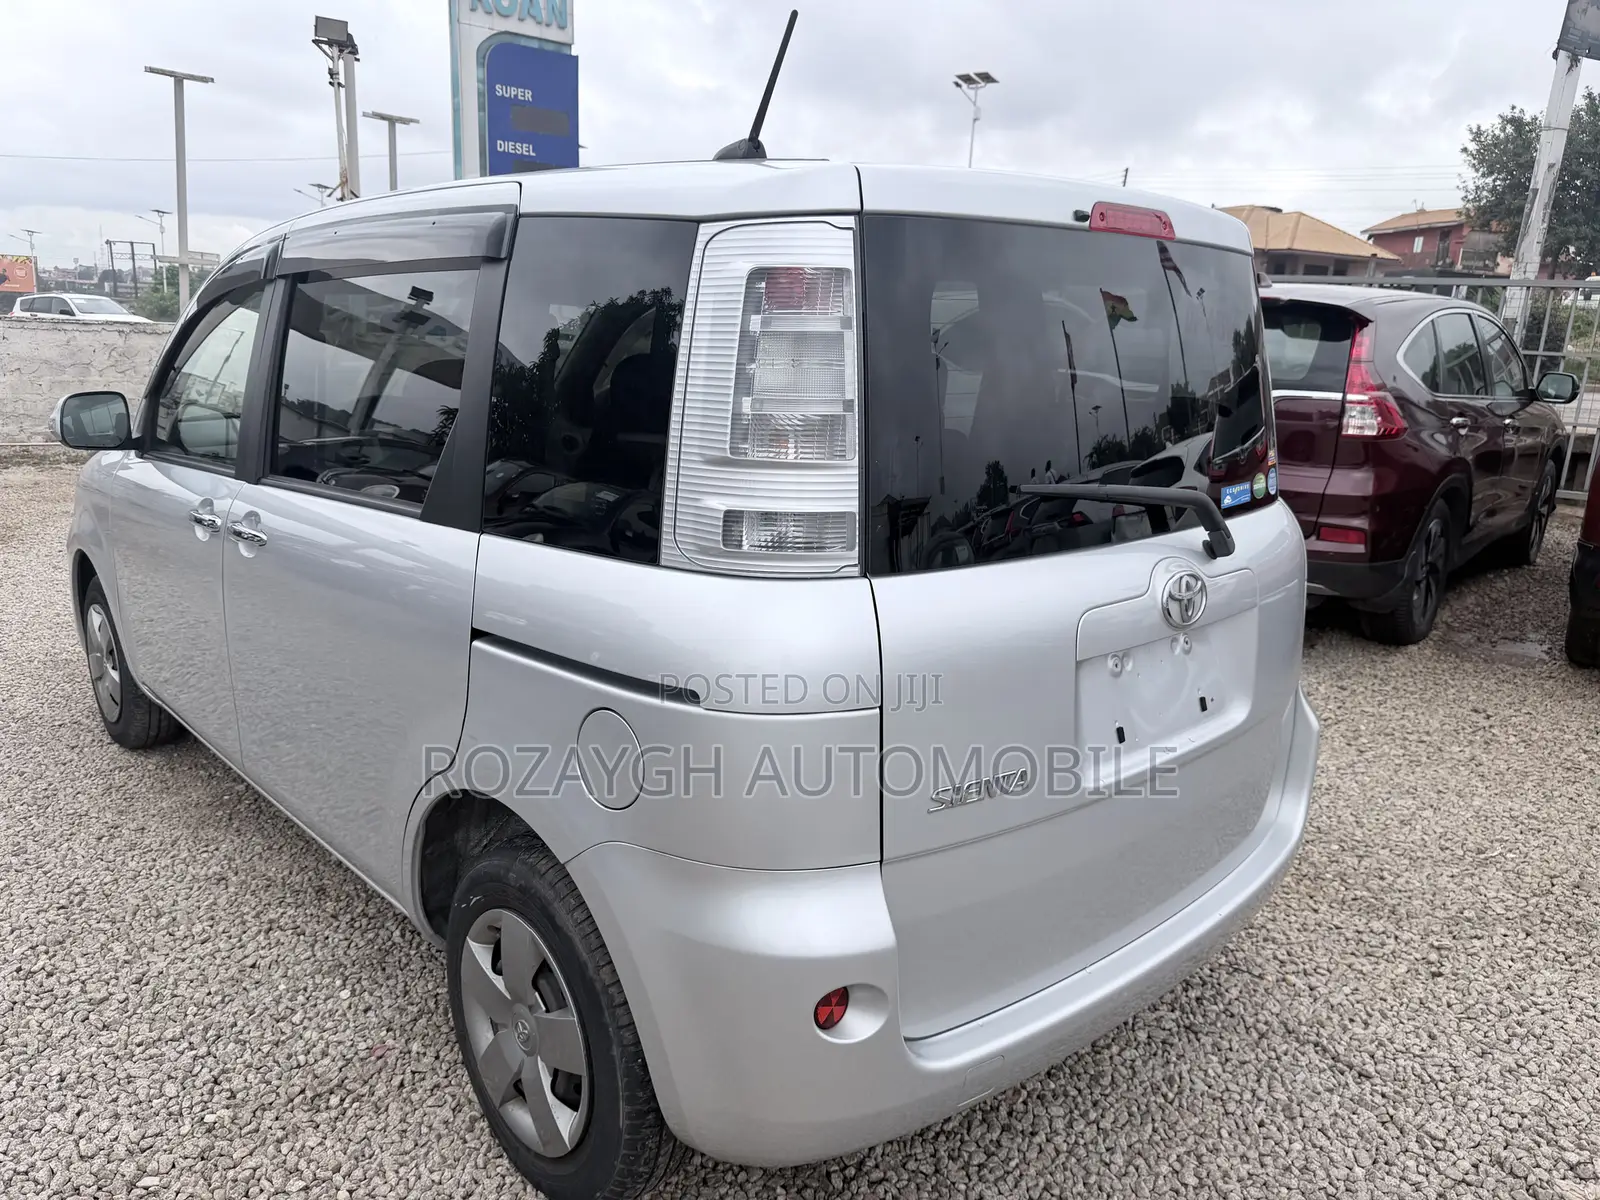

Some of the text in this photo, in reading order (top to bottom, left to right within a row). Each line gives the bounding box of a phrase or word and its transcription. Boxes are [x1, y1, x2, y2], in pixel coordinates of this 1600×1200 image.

[495, 84, 533, 101] SUPER
[496, 140, 536, 156] DIESEL
[927, 767, 1028, 813] SIENTA
